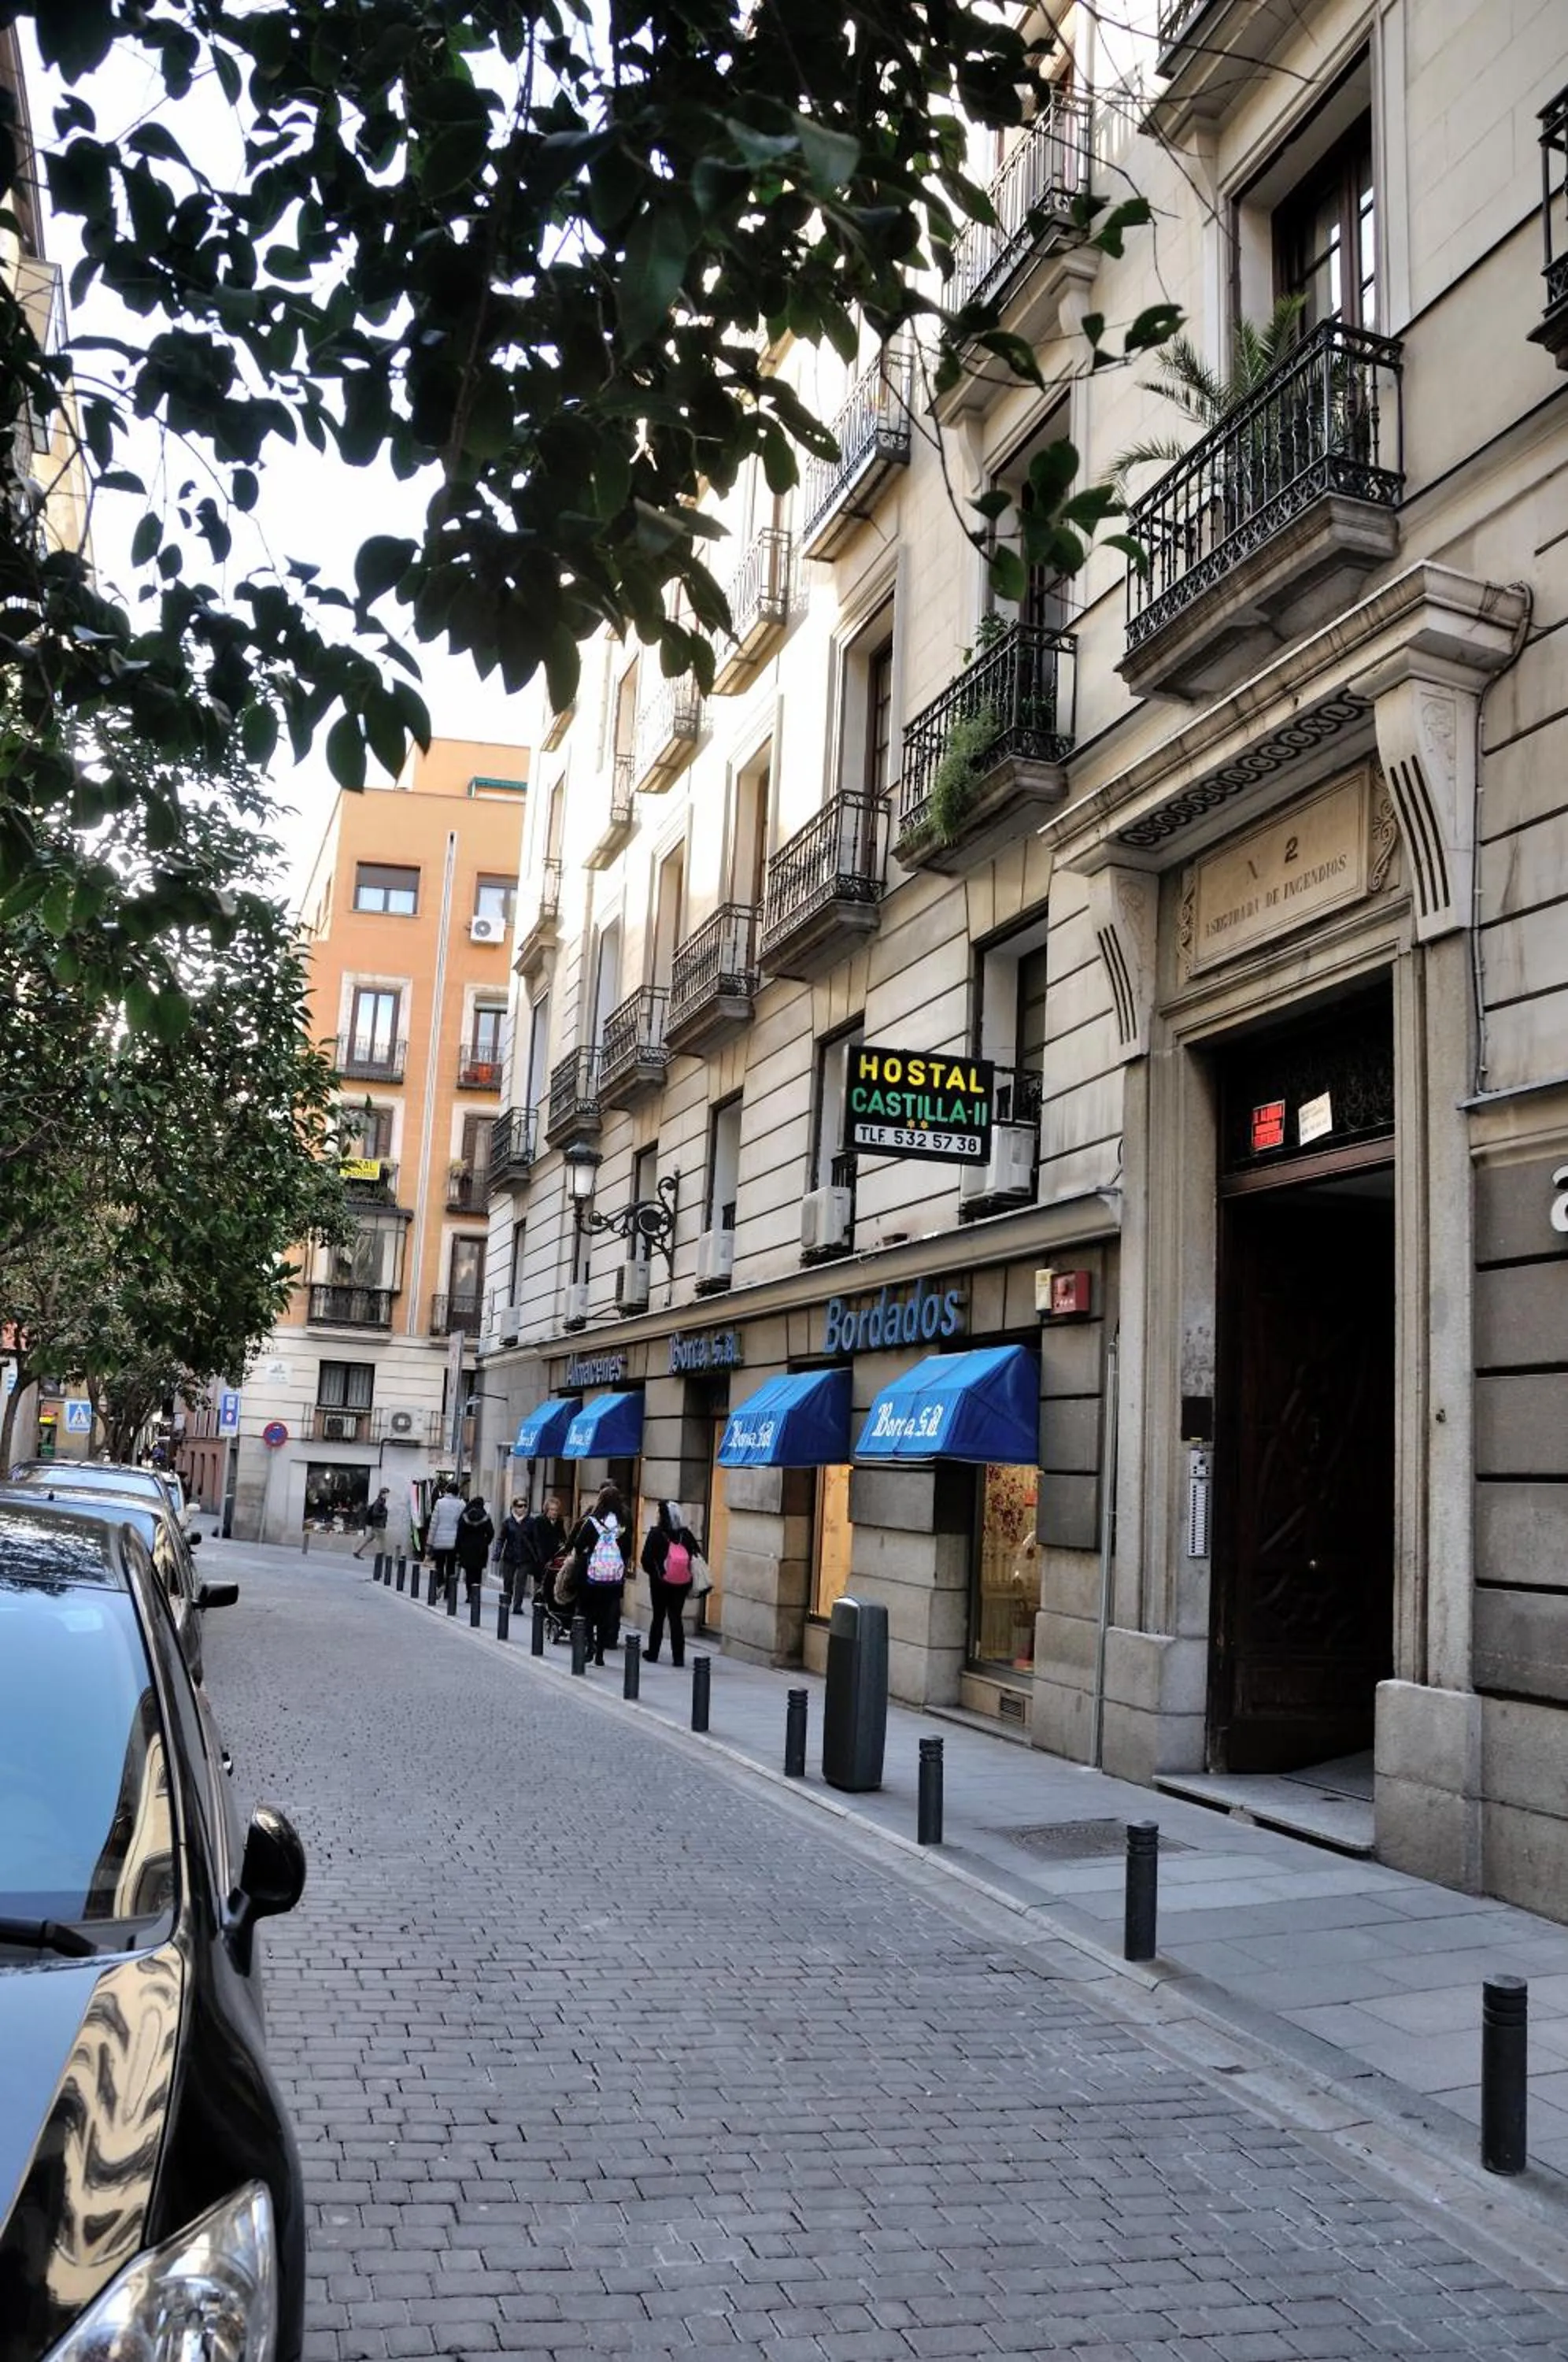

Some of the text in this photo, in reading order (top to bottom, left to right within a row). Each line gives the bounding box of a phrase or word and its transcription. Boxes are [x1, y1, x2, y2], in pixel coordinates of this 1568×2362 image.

[1284, 835, 1299, 864] 2
[1283, 853, 1347, 901] INCENDIOS
[859, 1053, 985, 1094] HOSTAL
[851, 1087, 988, 1127] CASTILLA-II
[893, 1130, 927, 1147] 532
[933, 1133, 953, 1150] 57
[956, 1135, 977, 1153] 38
[823, 1279, 959, 1354] Bordados
[566, 1353, 624, 1386] Almacenes
